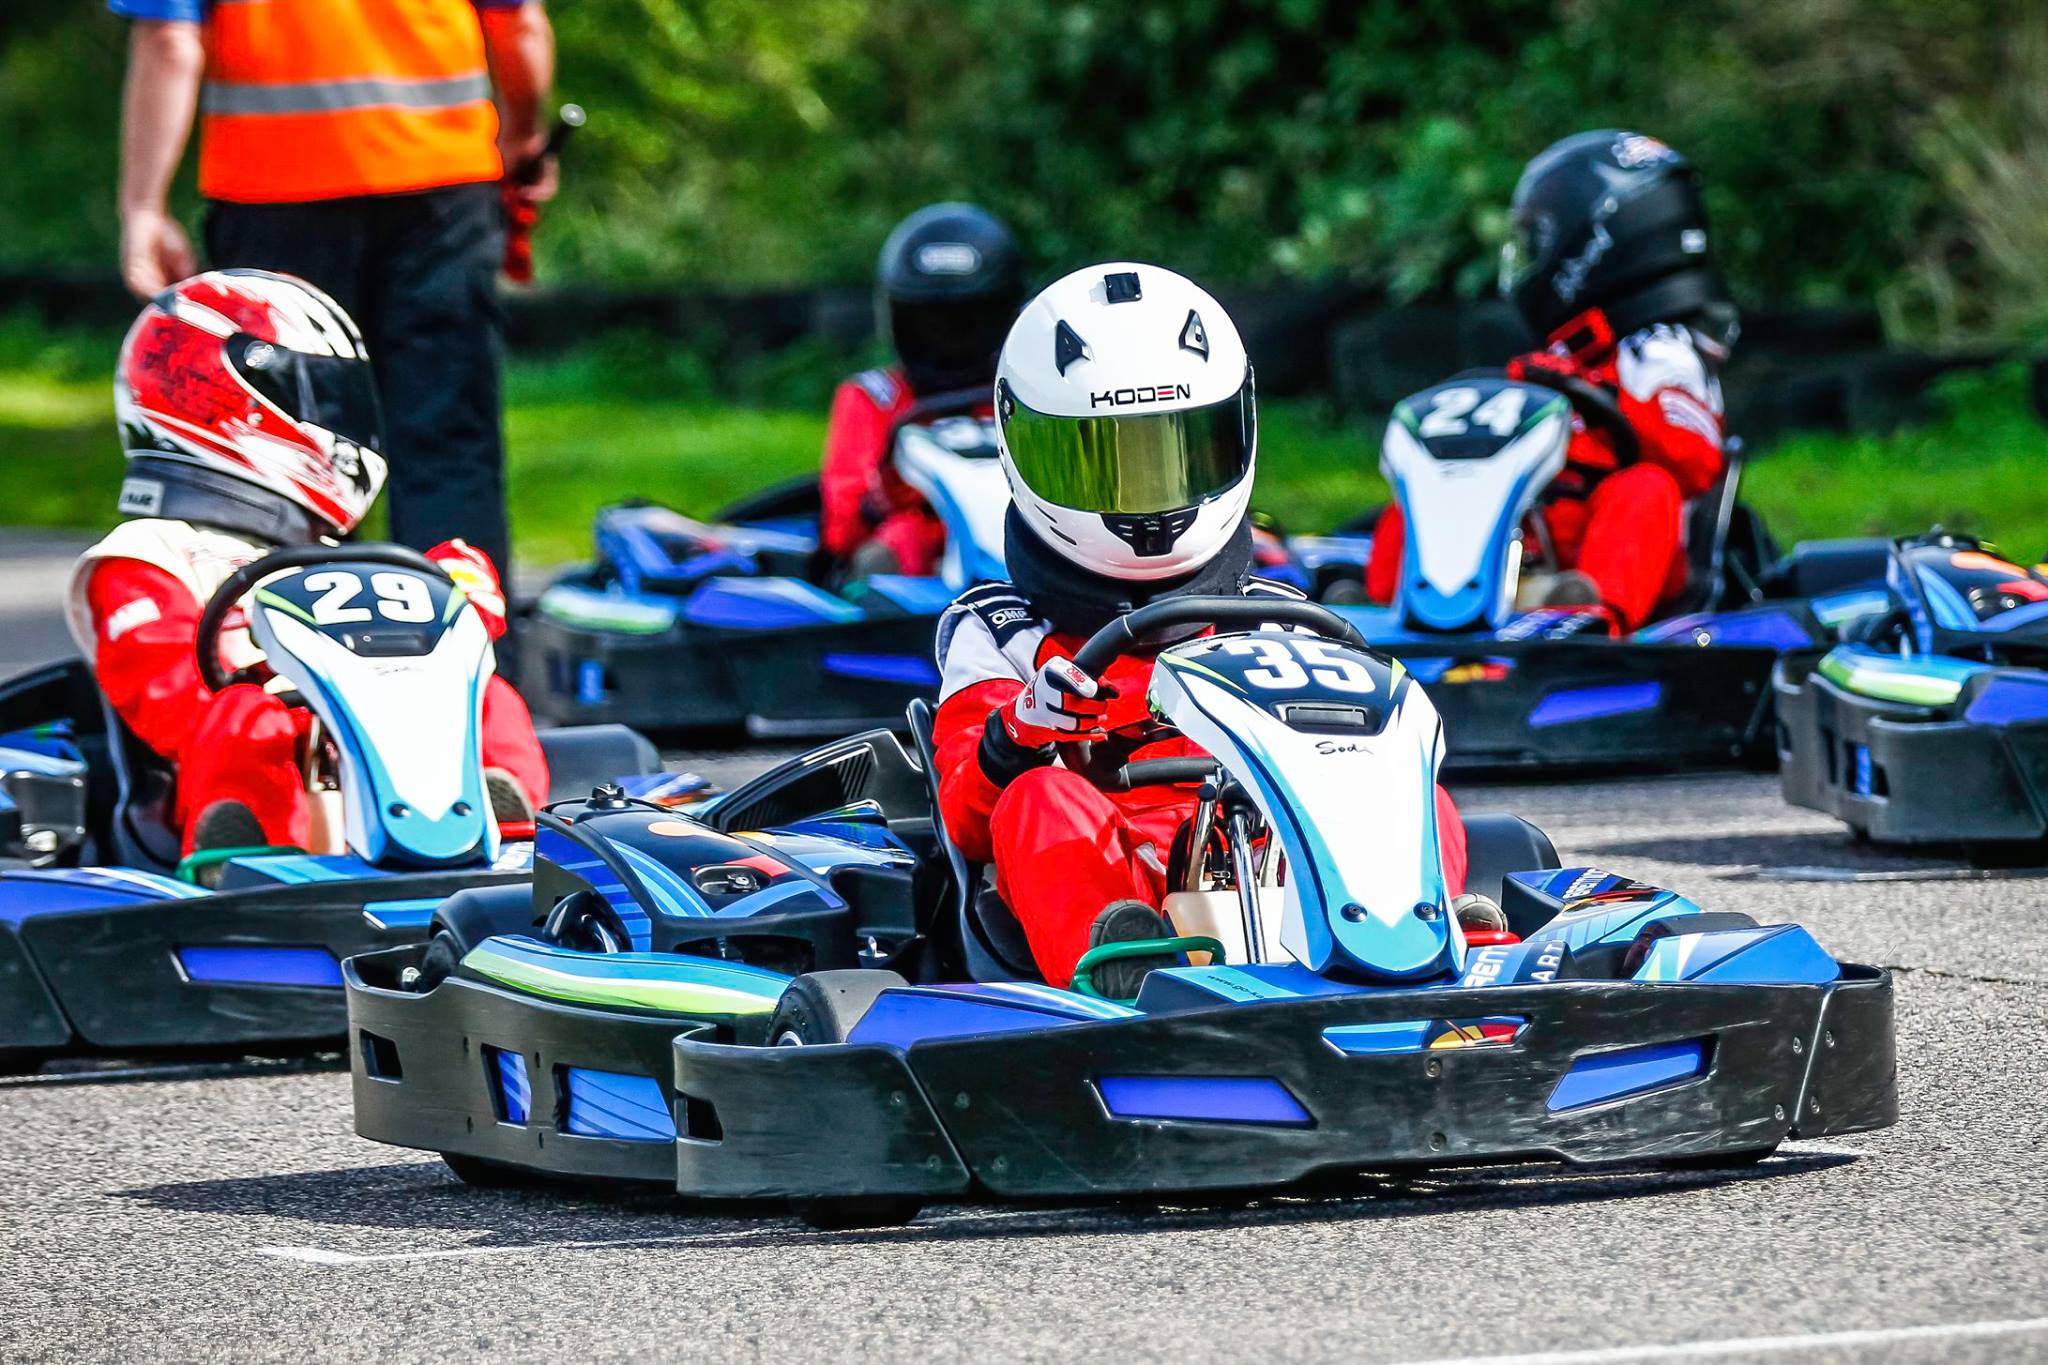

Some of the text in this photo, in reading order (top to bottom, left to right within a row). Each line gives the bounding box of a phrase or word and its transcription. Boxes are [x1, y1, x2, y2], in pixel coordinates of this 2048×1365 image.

[1090, 384, 1190, 408] KODEN
[1419, 388, 1528, 438] 24
[304, 572, 436, 626] 29
[992, 609, 1027, 625] OMP
[1066, 667, 1086, 684] OMP
[1223, 639, 1376, 693] 35
